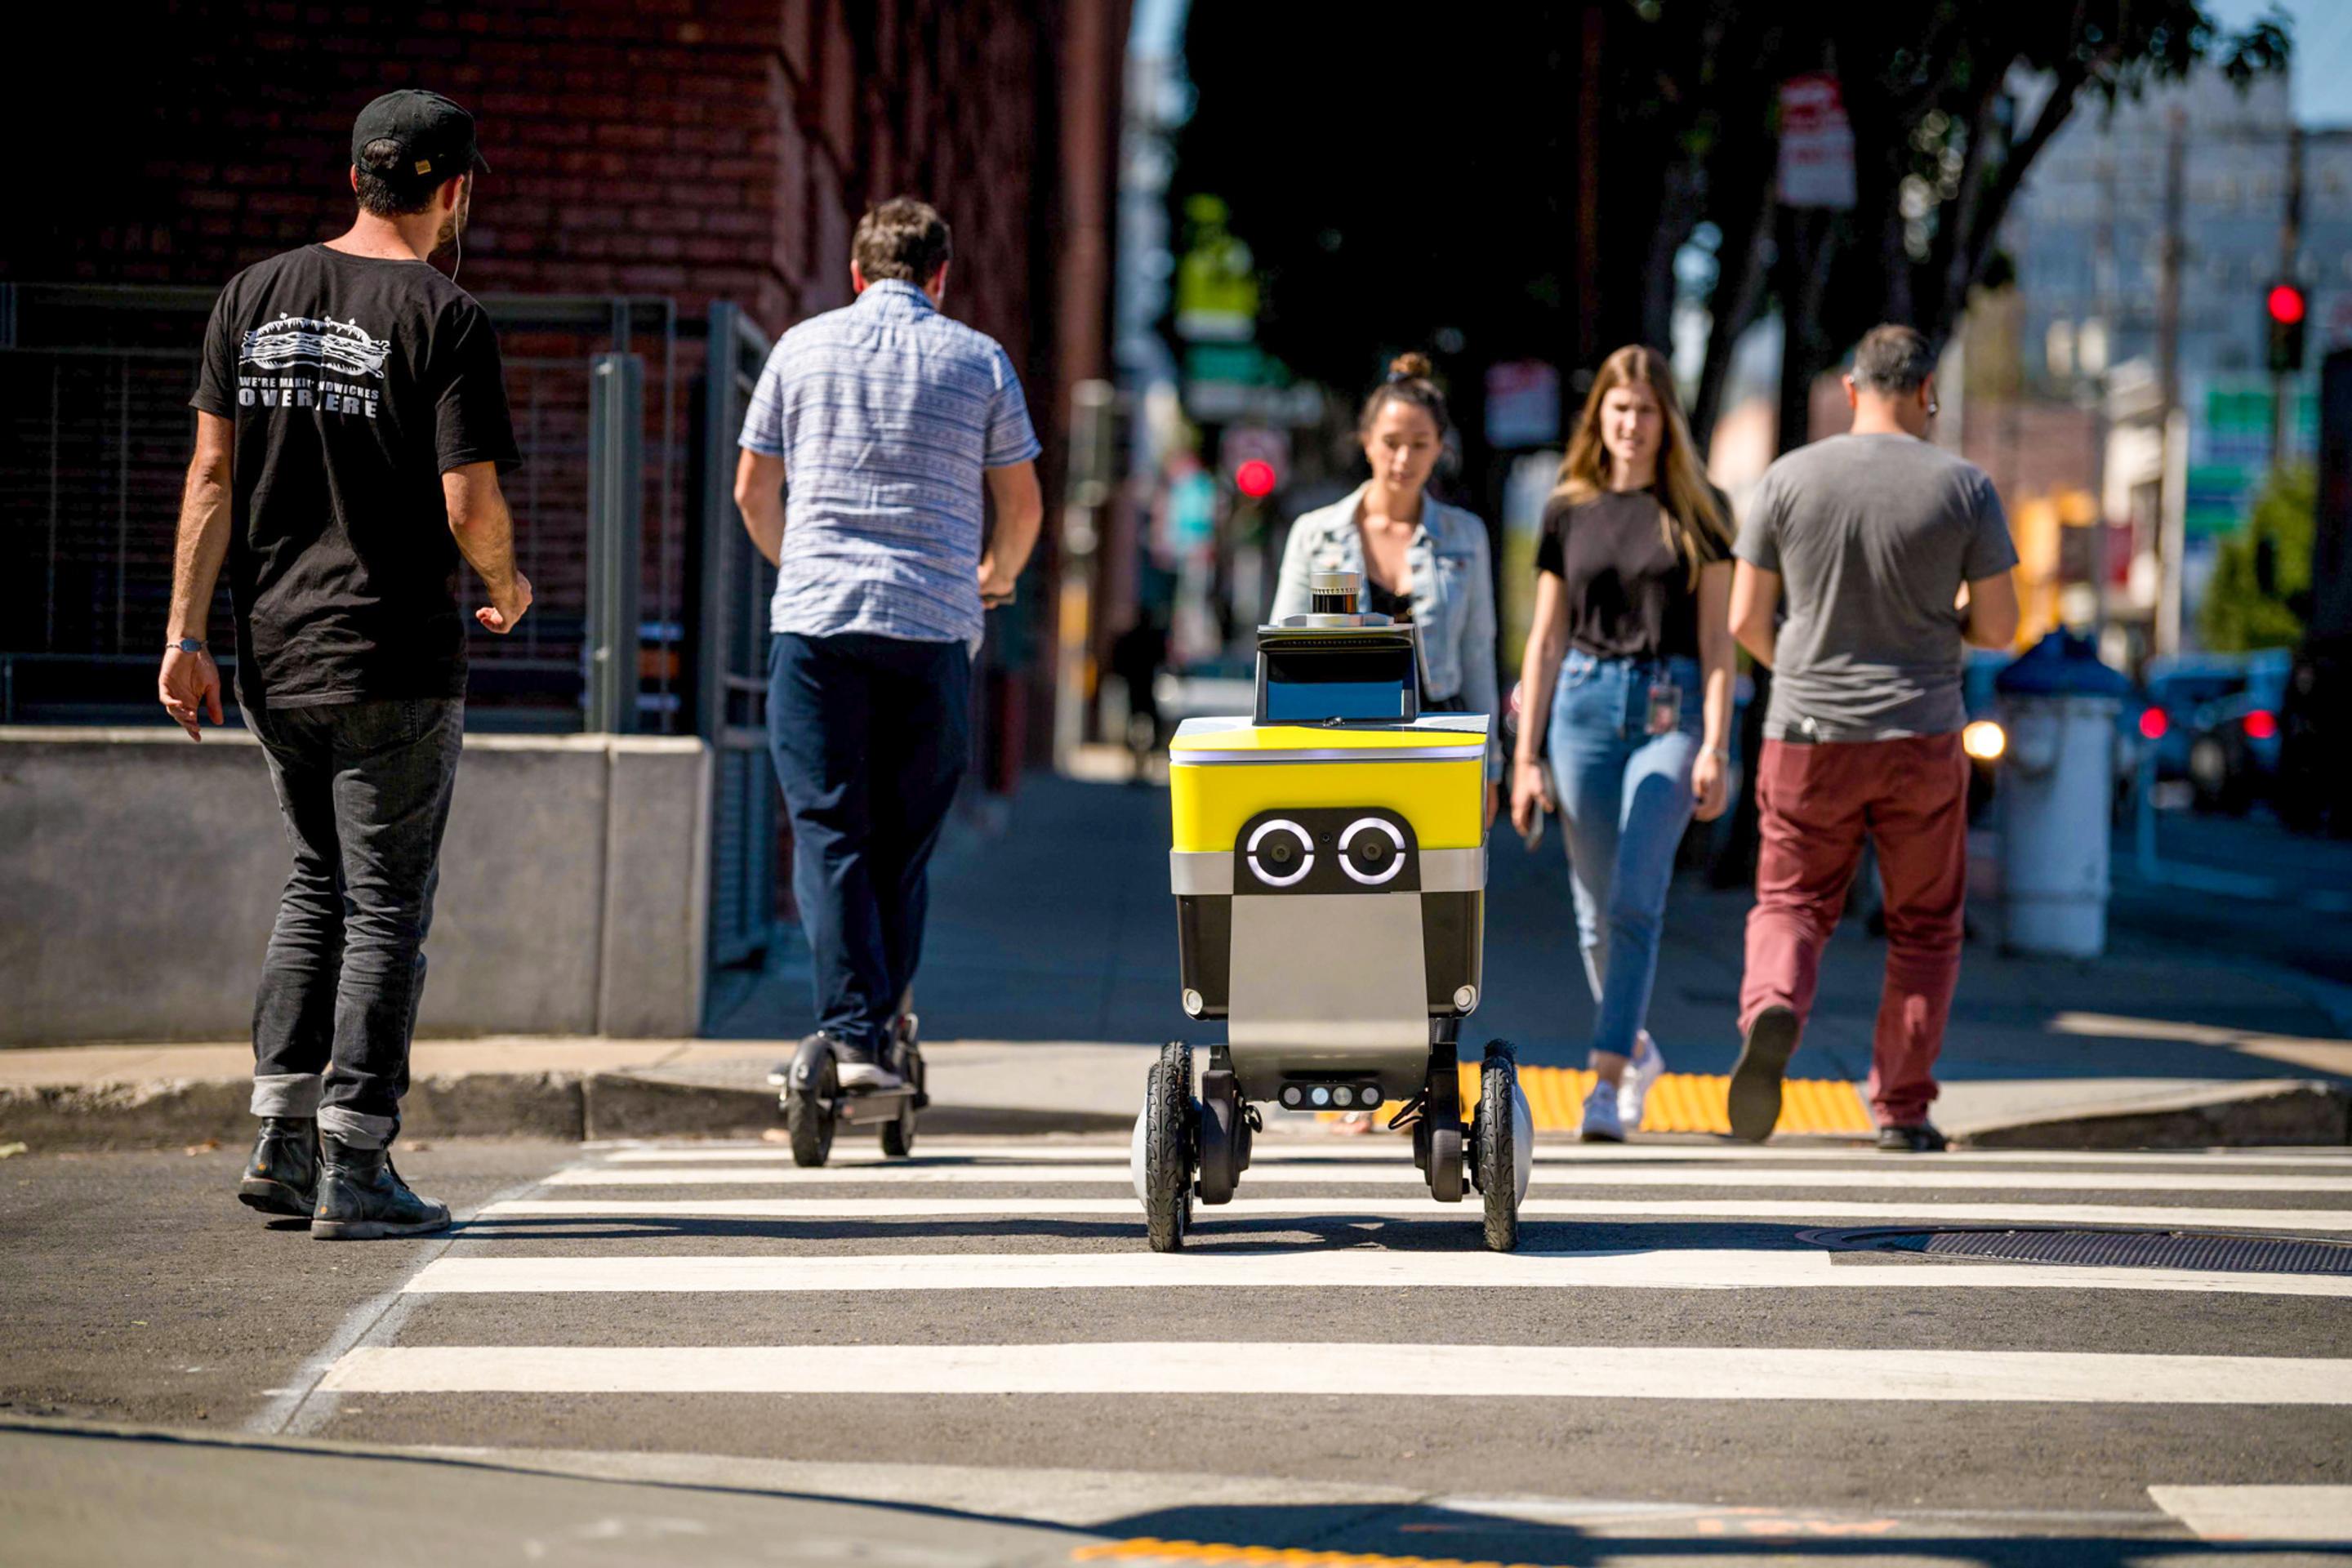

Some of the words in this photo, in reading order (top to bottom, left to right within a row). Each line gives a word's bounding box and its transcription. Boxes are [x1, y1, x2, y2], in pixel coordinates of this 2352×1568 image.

[238, 376, 277, 388] WE'RE
[317, 380, 380, 400] NDWICHES
[238, 387, 314, 408] OVER
[315, 393, 378, 419] ERE
